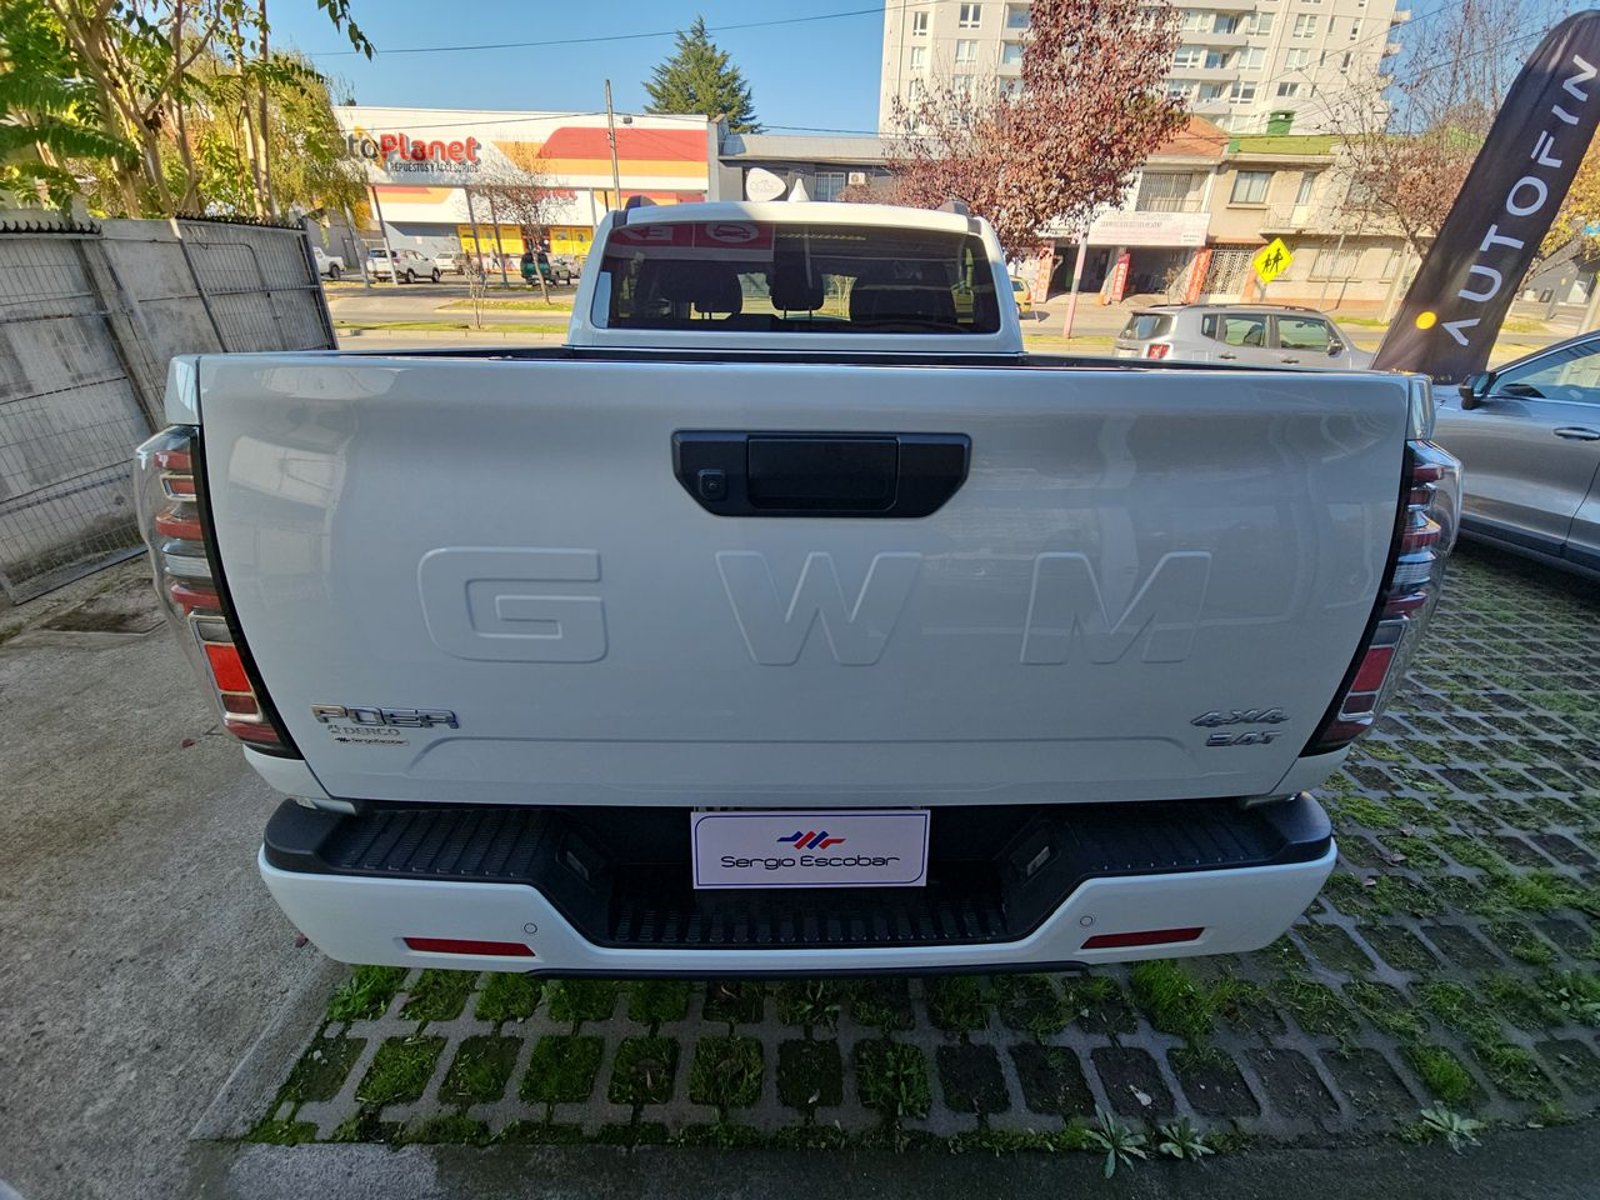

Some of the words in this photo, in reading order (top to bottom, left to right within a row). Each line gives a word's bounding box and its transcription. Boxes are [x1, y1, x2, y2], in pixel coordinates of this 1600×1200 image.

[347, 132, 482, 164] toPlanet
[1441, 54, 1598, 346] AUTOFIN
[311, 704, 459, 729] POER
[343, 727, 401, 736] DERCO
[721, 855, 796, 870] Sergio
[800, 854, 900, 867] Escobar
